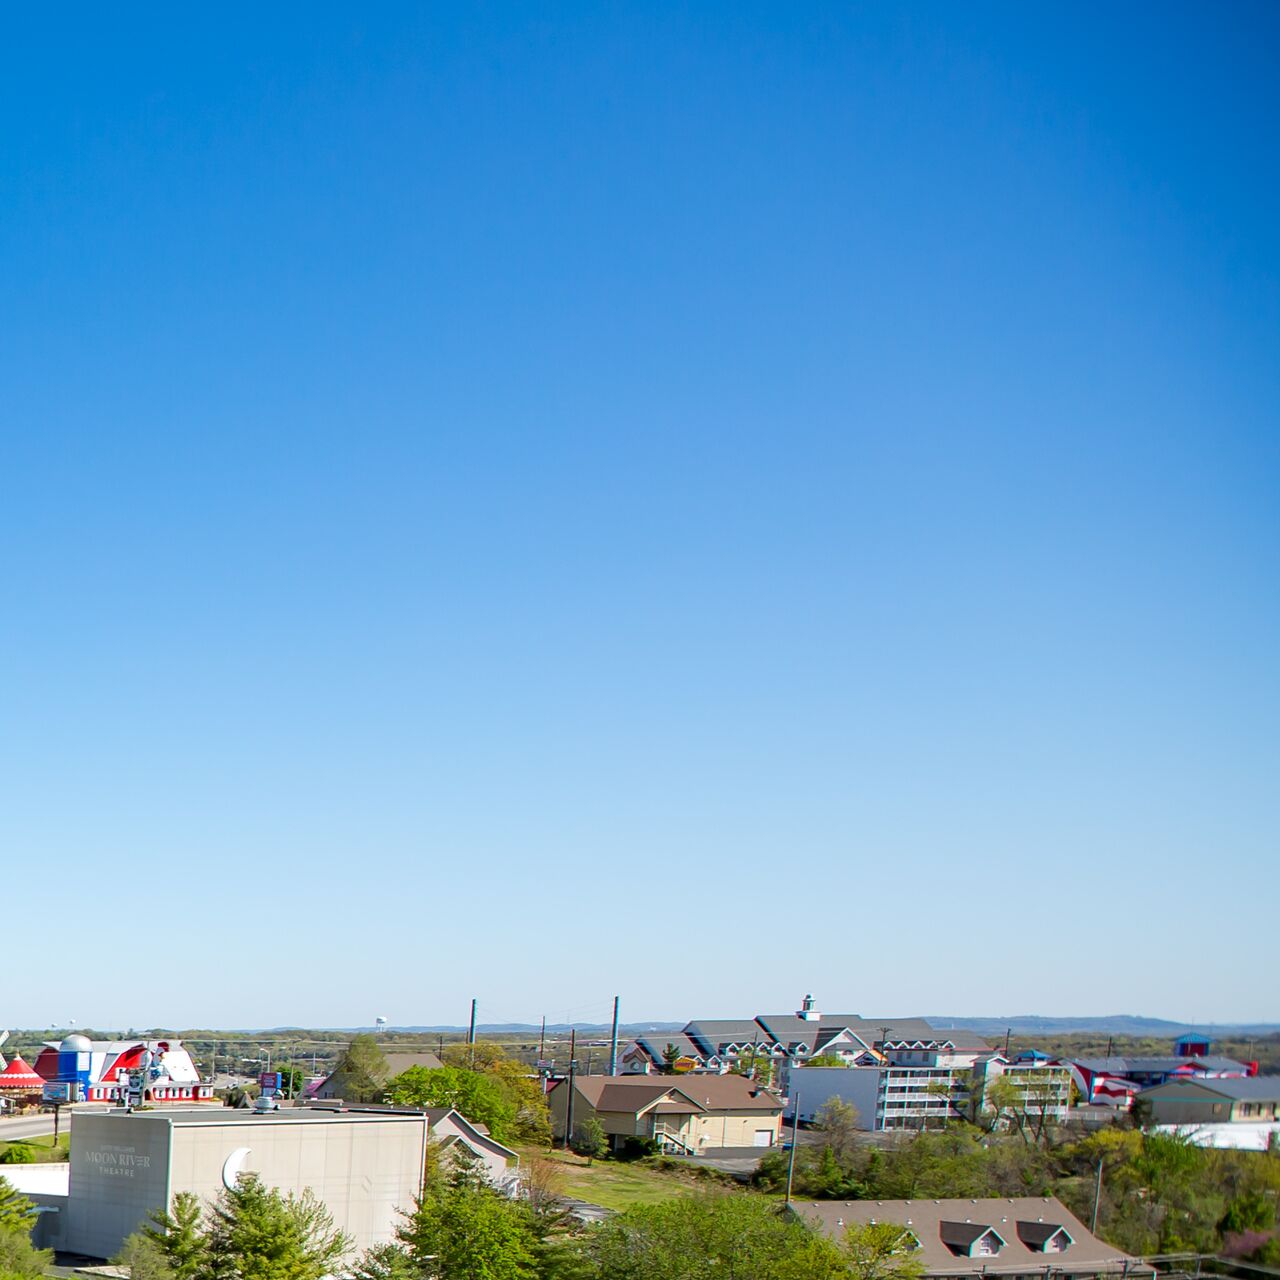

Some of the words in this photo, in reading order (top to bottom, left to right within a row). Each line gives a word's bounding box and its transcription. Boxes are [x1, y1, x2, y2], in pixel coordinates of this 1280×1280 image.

[85, 1151, 117, 1164] MOON
[119, 1154, 150, 1168] RIVER
[99, 1166, 135, 1177] THEATRE
